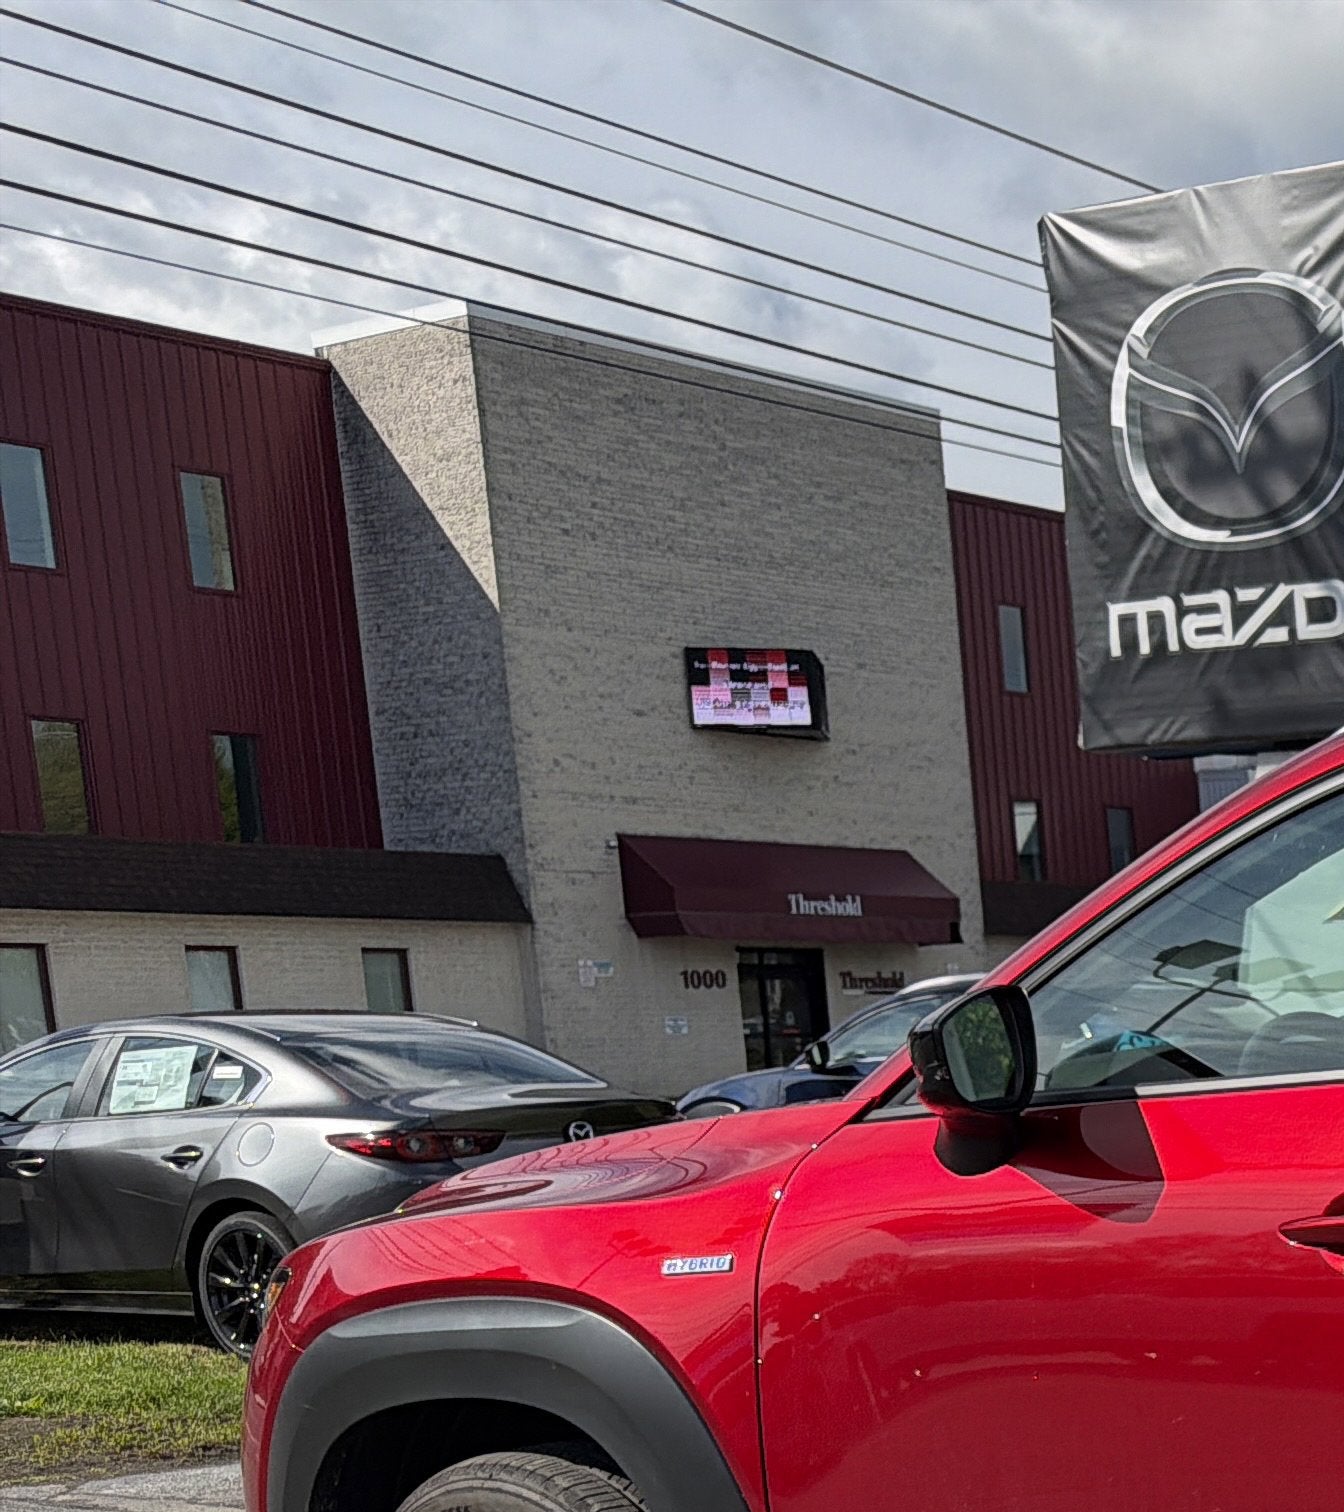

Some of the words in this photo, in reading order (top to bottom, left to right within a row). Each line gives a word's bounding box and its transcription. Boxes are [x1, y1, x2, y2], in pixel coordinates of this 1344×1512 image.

[788, 893, 862, 917] Threshold
[680, 969, 726, 990] 1000
[839, 970, 904, 989] Threshold
